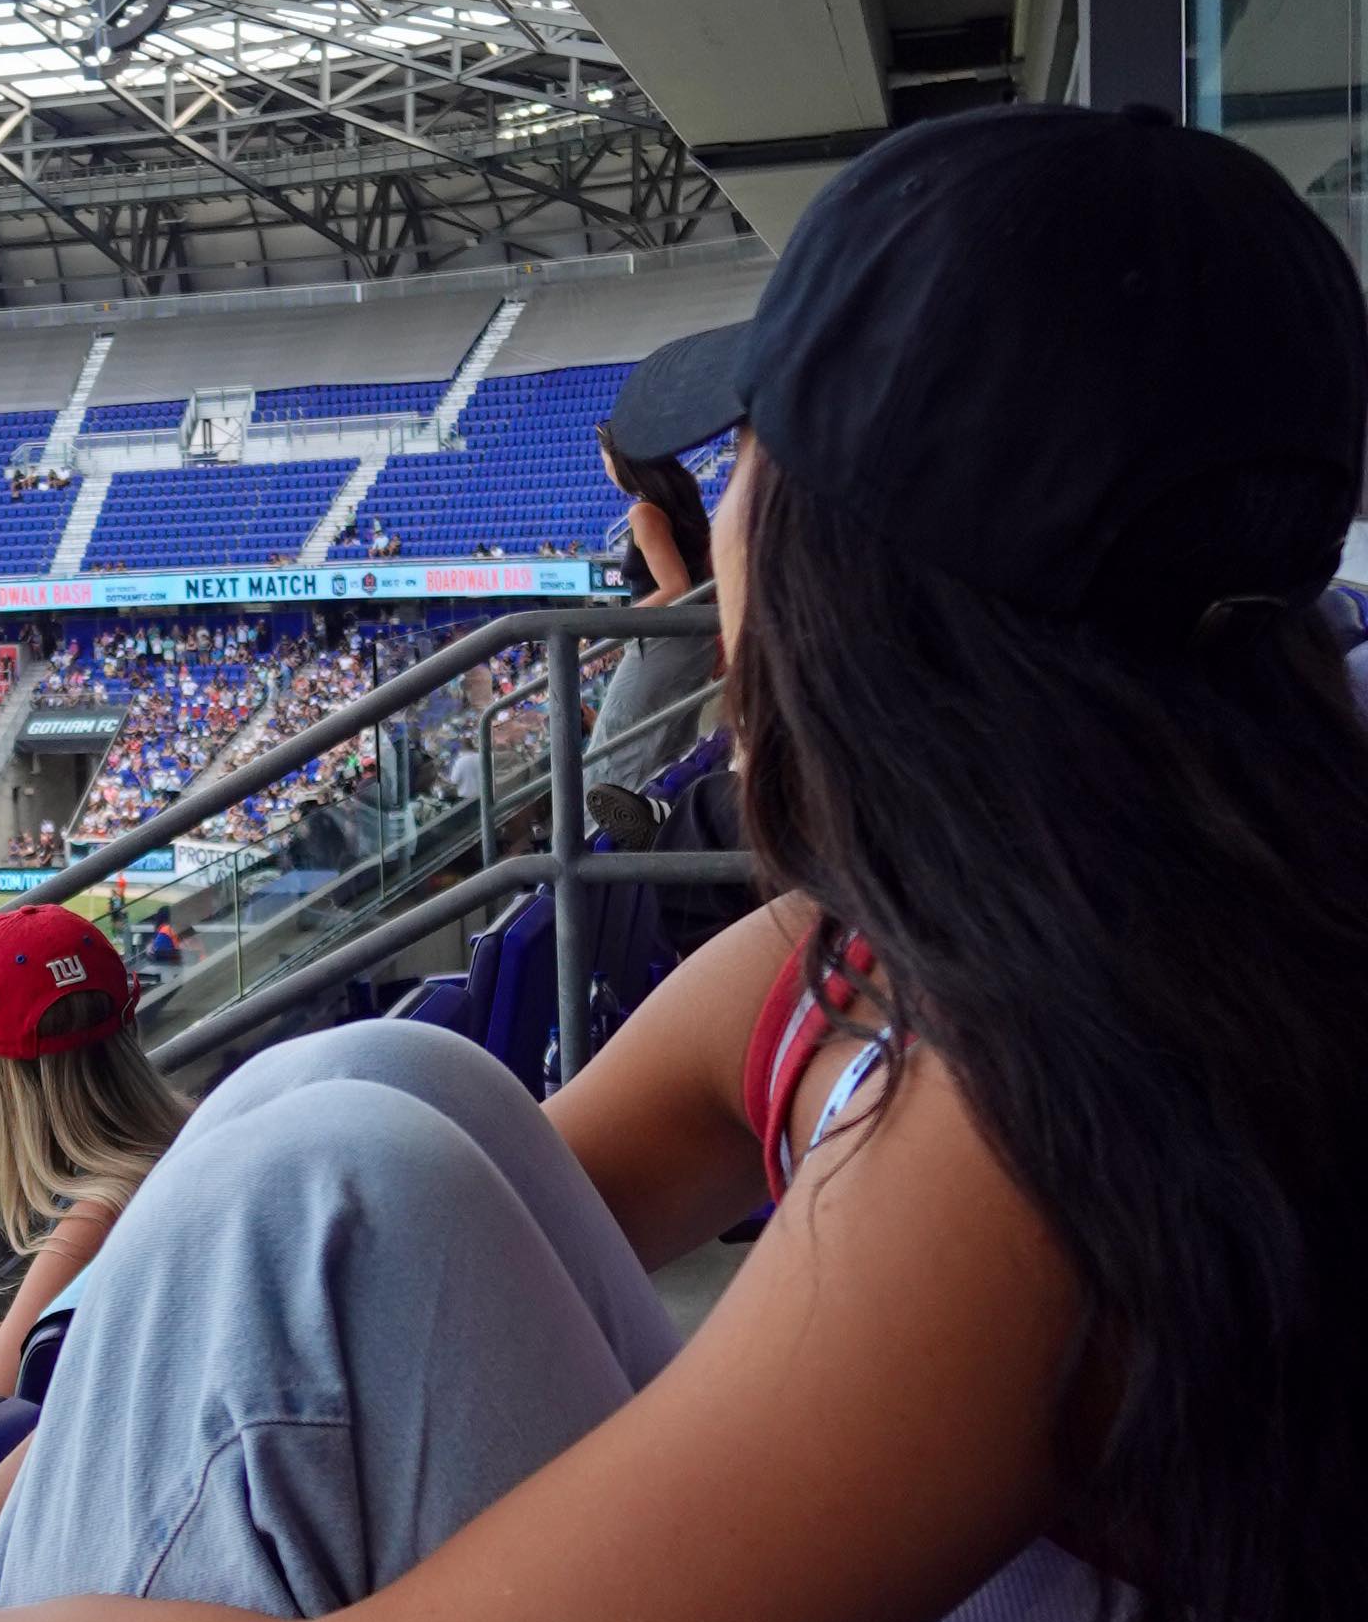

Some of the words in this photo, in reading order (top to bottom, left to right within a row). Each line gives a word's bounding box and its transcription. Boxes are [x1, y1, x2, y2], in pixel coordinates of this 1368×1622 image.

[185, 577, 239, 599] NEXT
[248, 575, 317, 597] MATCH
[426, 569, 499, 593] BOARDWALK
[504, 567, 532, 591] BASH
[605, 570, 623, 586] GFC
[53, 583, 92, 605] BASH
[27, 719, 95, 735] GOTHAM
[96, 718, 119, 732] FC
